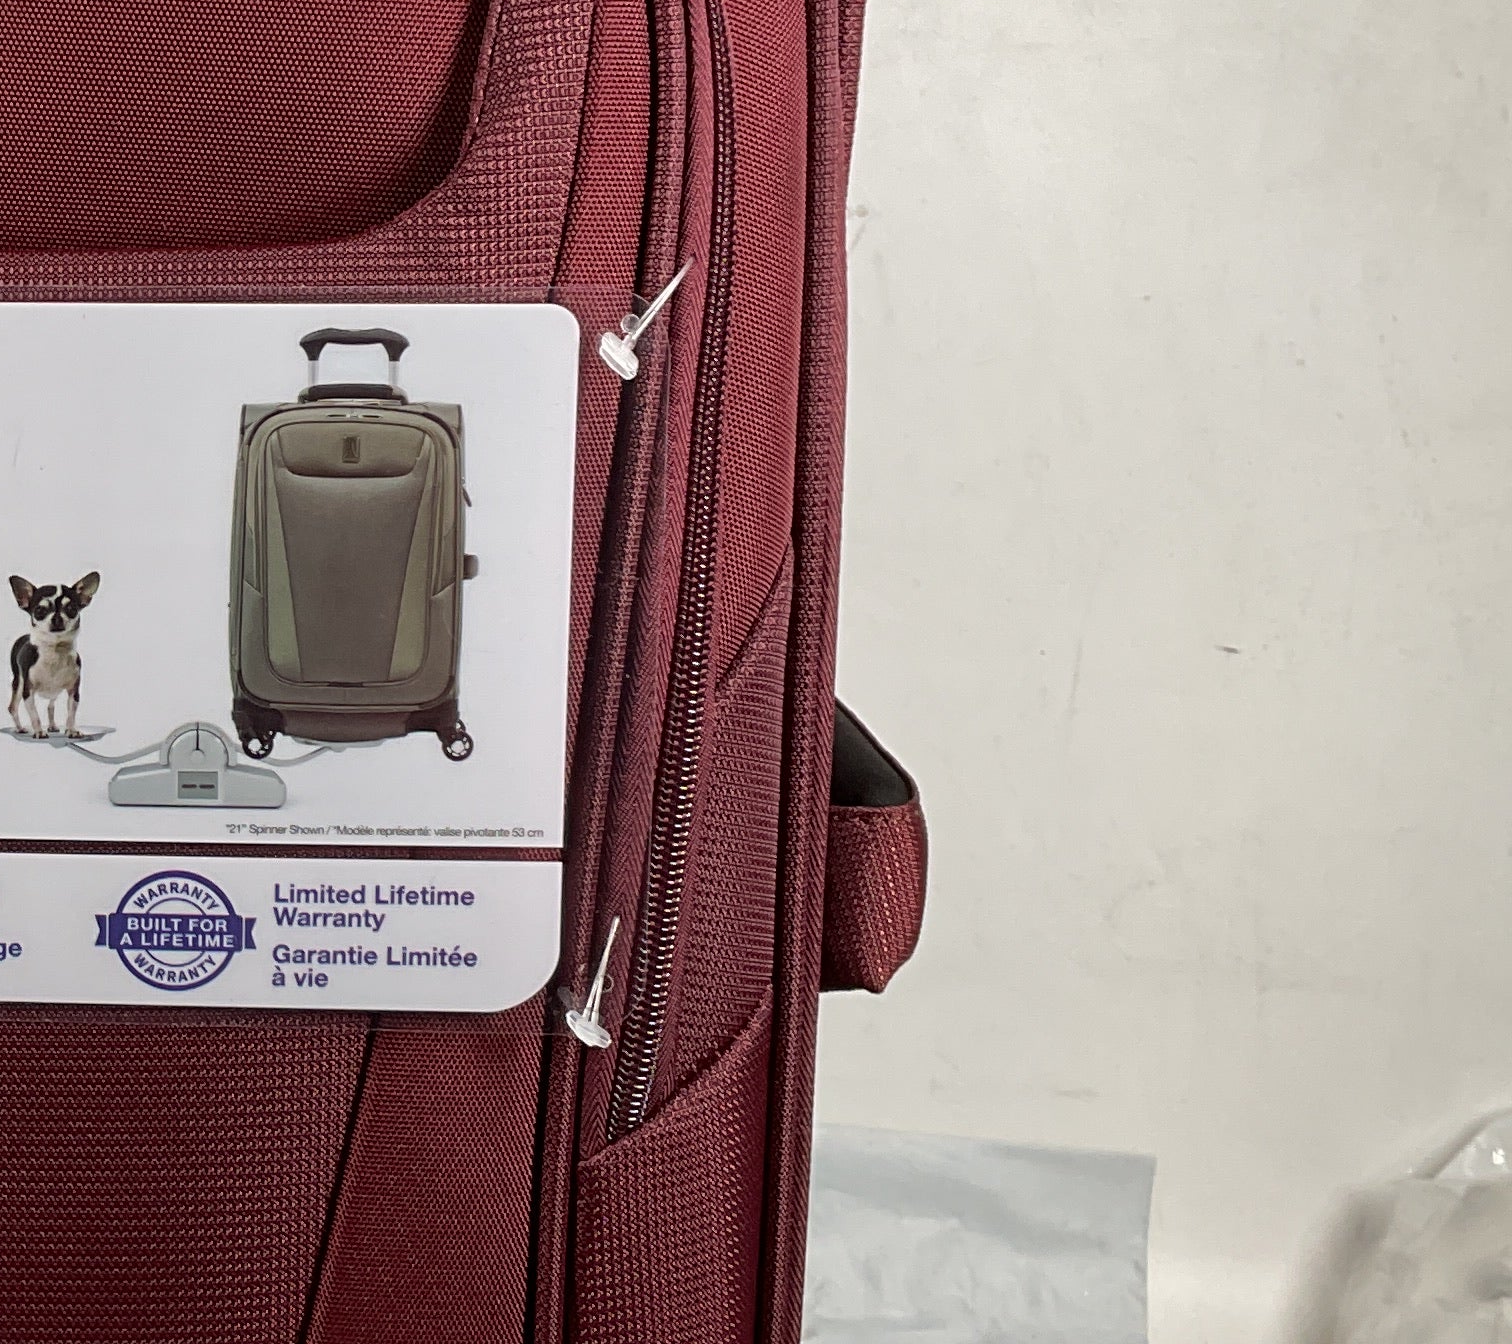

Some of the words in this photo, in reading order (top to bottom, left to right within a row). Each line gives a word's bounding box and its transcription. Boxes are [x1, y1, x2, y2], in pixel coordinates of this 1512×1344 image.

[248, 823, 288, 837] Spinner
[289, 824, 325, 835] Shown
[511, 827, 525, 838] 53
[527, 829, 544, 838] cm
[133, 881, 221, 912] WARRANTY
[273, 882, 366, 904] Limited
[375, 884, 475, 906] Lifetime
[126, 917, 183, 932] BUILT
[188, 918, 228, 933] FOR
[272, 906, 386, 933] Warranty
[119, 932, 133, 946] A
[140, 932, 235, 948] LIFETIME
[272, 943, 378, 965] Garantie
[386, 944, 478, 967] Limitée
[133, 952, 217, 984] WARRANTY
[271, 965, 286, 987] à
[293, 968, 329, 988] vie
